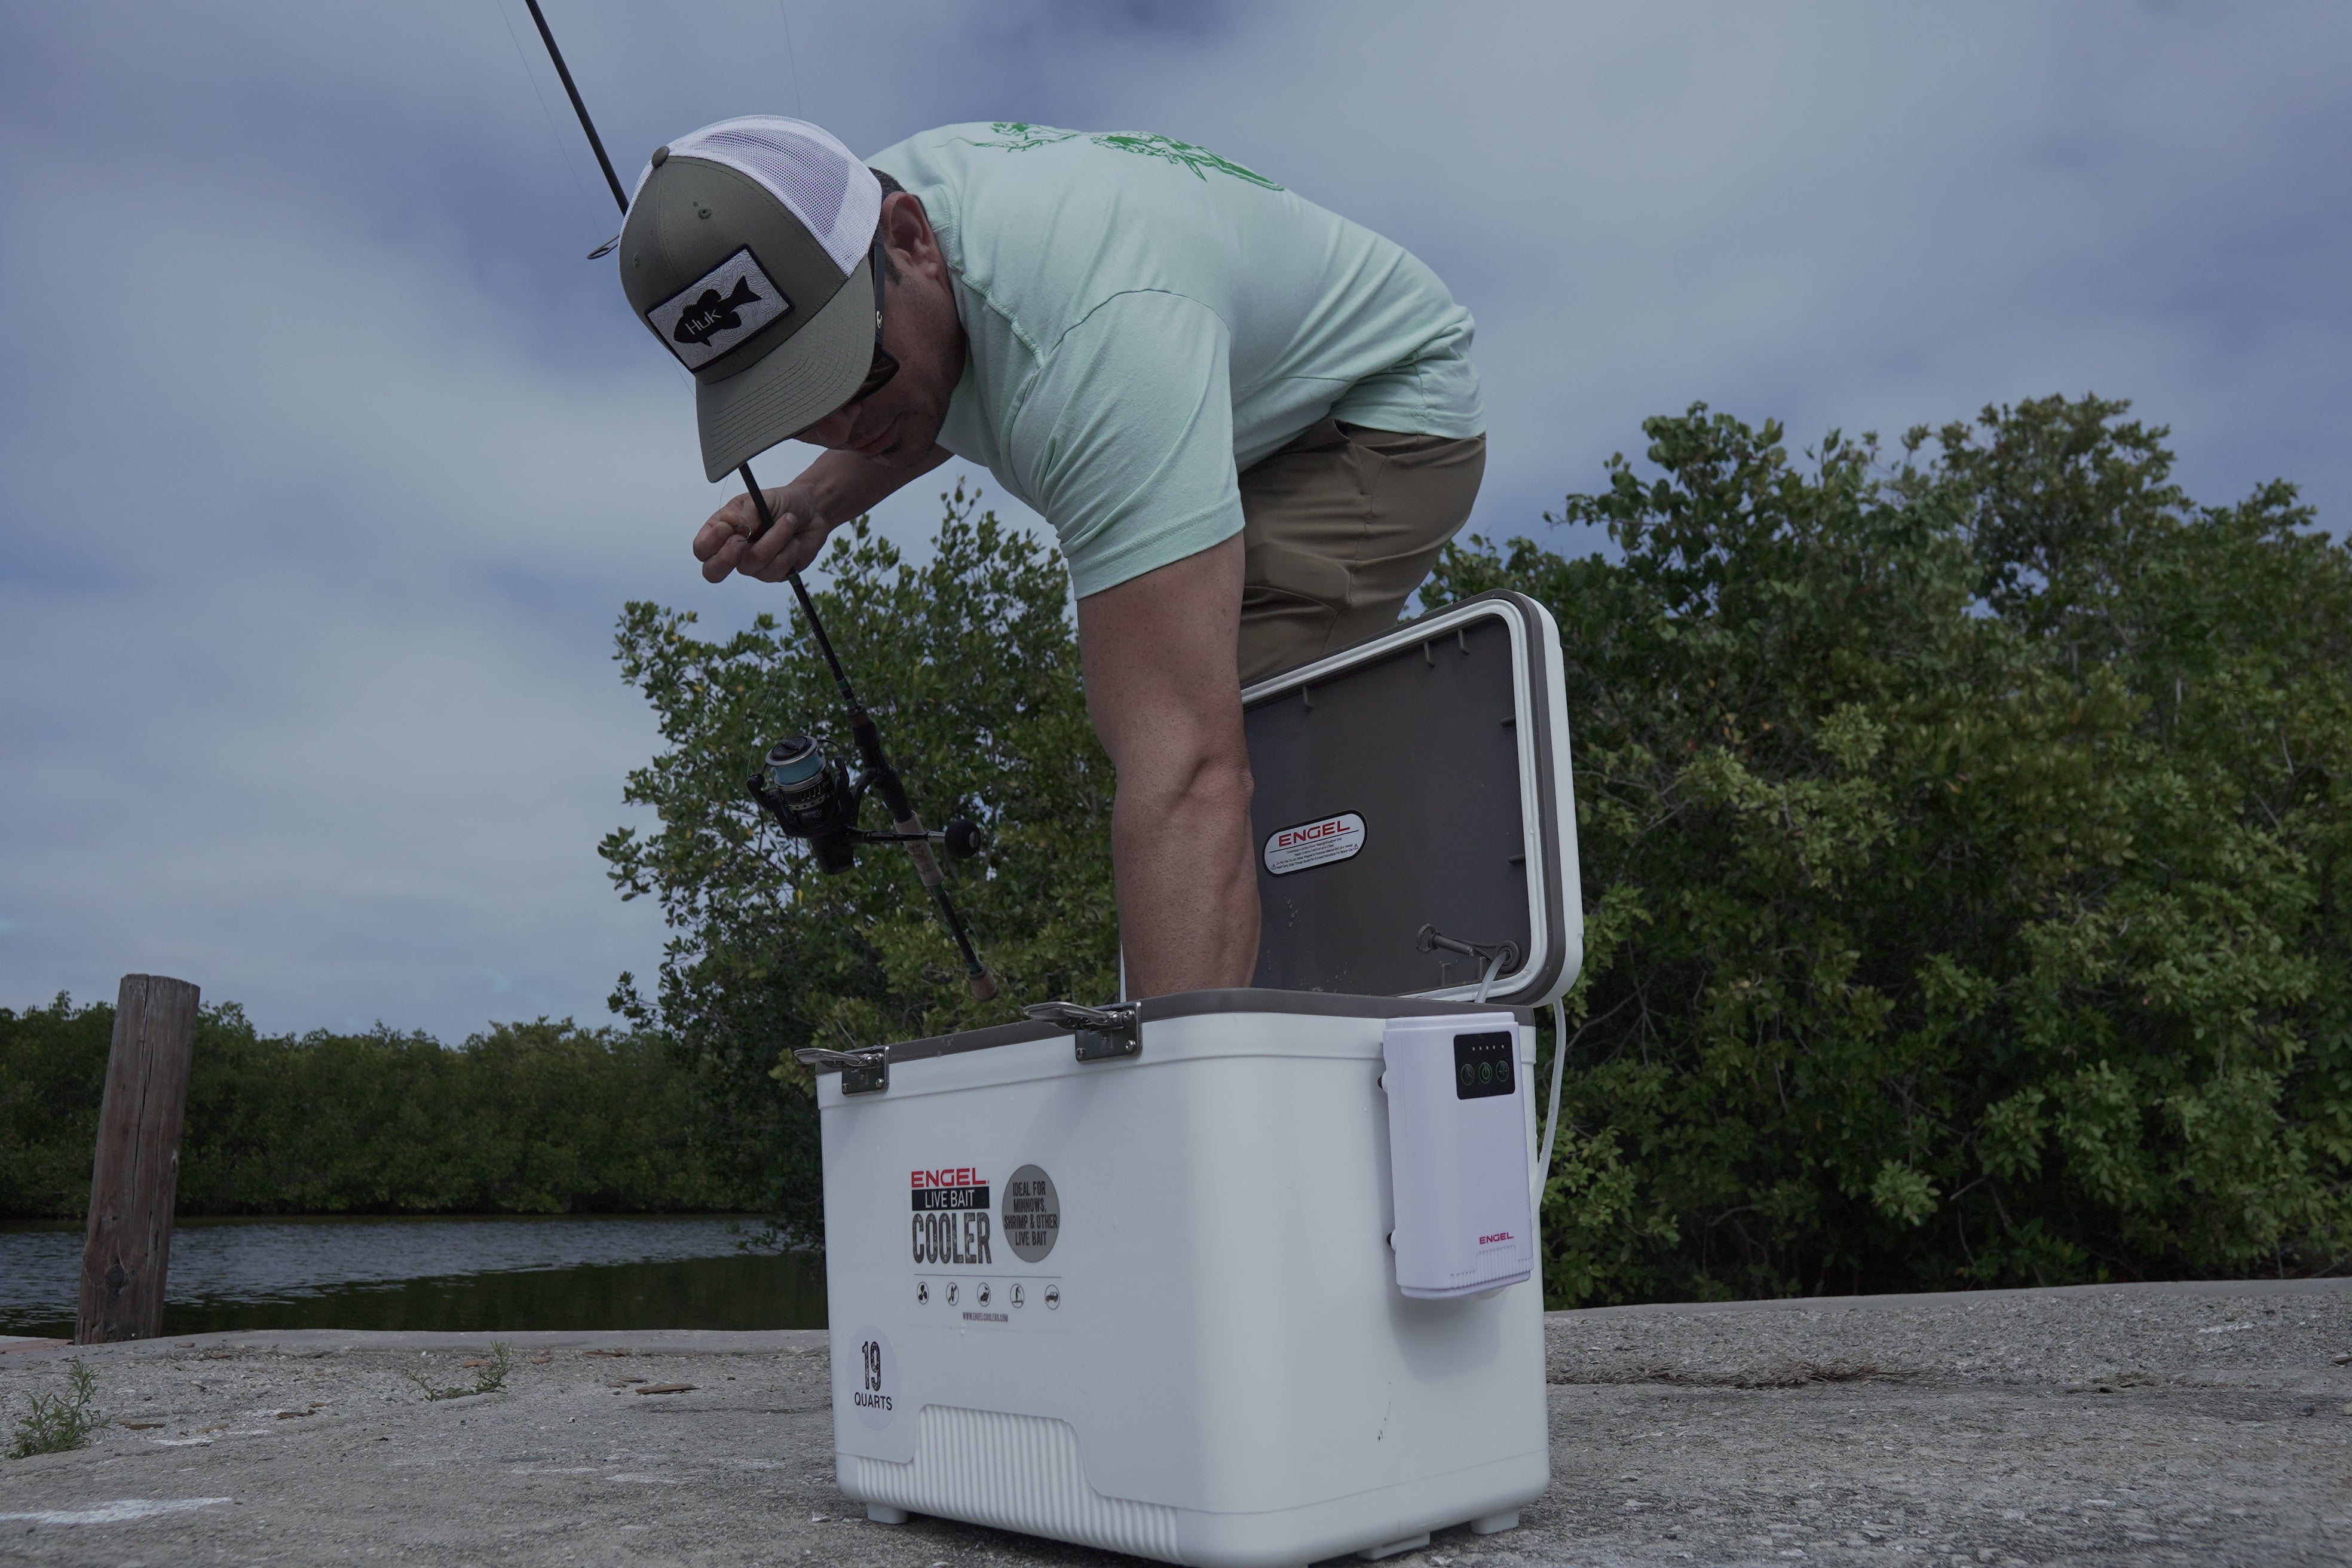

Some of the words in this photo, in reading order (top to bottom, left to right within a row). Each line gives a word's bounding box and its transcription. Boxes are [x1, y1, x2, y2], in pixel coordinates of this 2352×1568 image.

[1279, 820, 1350, 847] ENGEL
[911, 1168, 986, 1188] ENGEL
[1012, 1182, 1030, 1196] IDEAL
[1033, 1181, 1046, 1196] FOR
[925, 1190, 947, 1208] LIVE
[950, 1189, 975, 1208] BAIT
[1013, 1198, 1047, 1213] MINNOWS,
[1004, 1214, 1028, 1230] SHRIMP
[1030, 1214, 1035, 1229] &
[1036, 1214, 1058, 1229] OTHER
[912, 1212, 992, 1264] COOLER
[1015, 1231, 1030, 1246] LIVE
[1031, 1230, 1047, 1246] BAIT
[1479, 1232, 1514, 1245] ENGEL
[862, 1341, 881, 1392] 19
[855, 1391, 893, 1411] QUARTS
